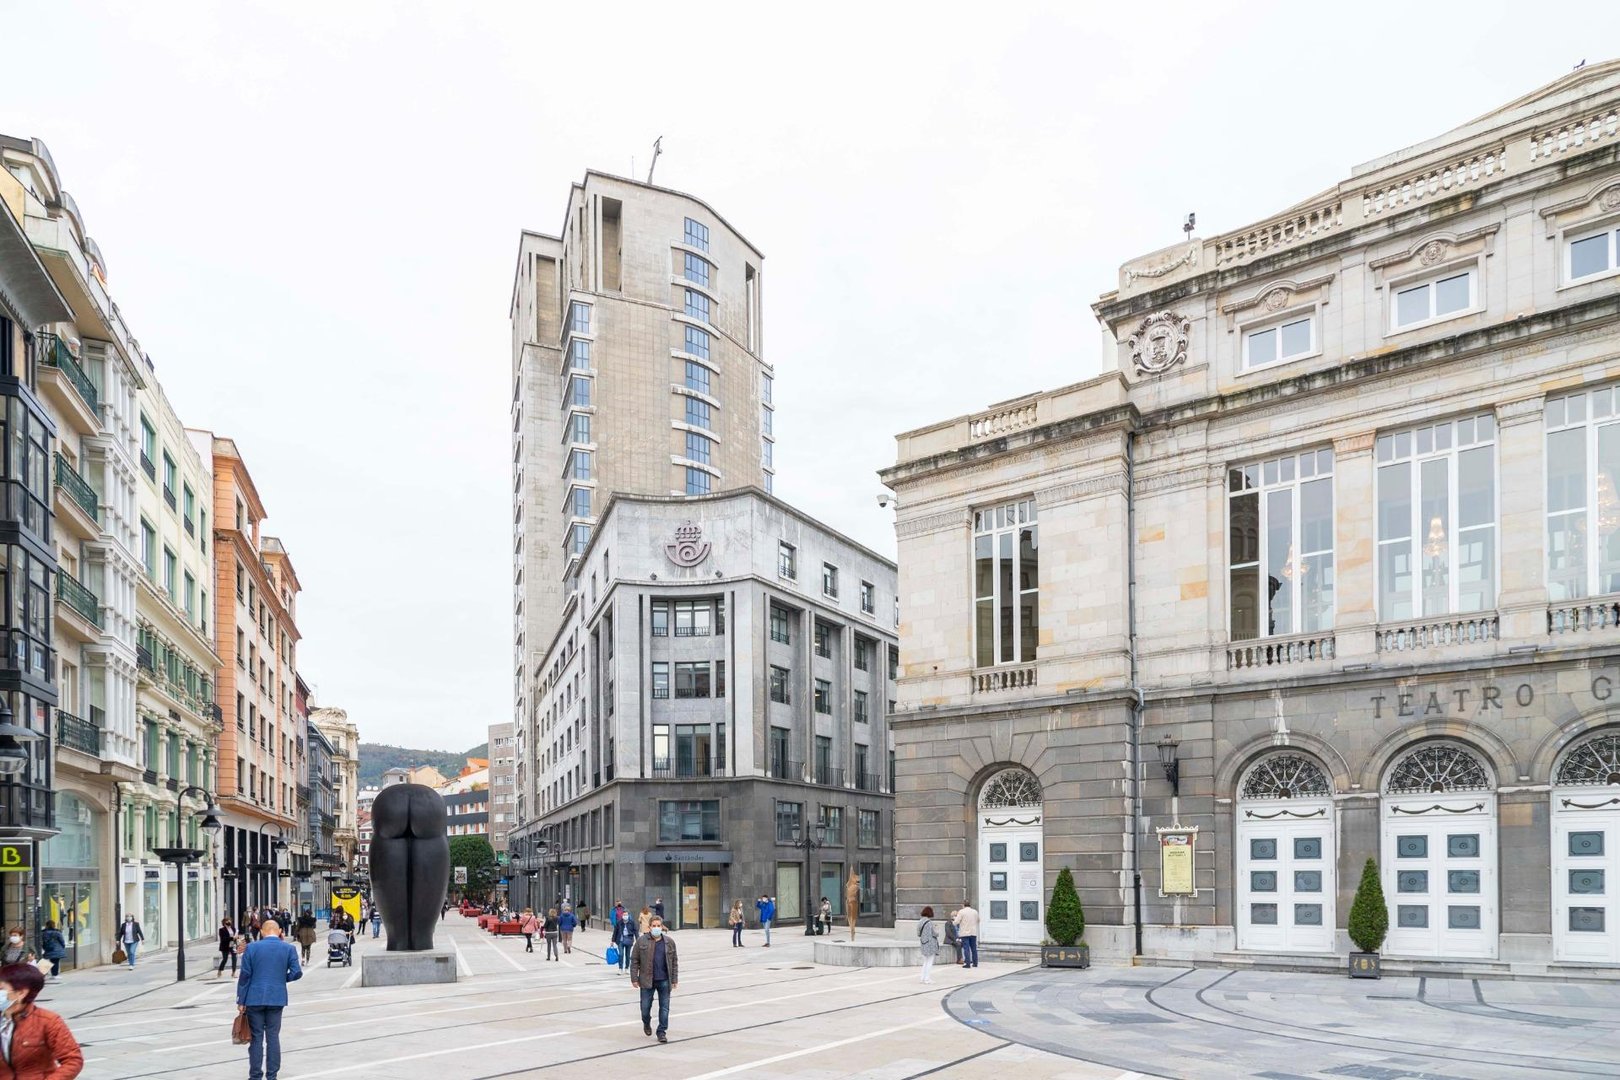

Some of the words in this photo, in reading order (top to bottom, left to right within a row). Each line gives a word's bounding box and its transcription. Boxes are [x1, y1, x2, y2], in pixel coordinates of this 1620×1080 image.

[1370, 683, 1534, 719] TEATRO
[2, 846, 21, 865] B
[673, 853, 705, 861] Santander
